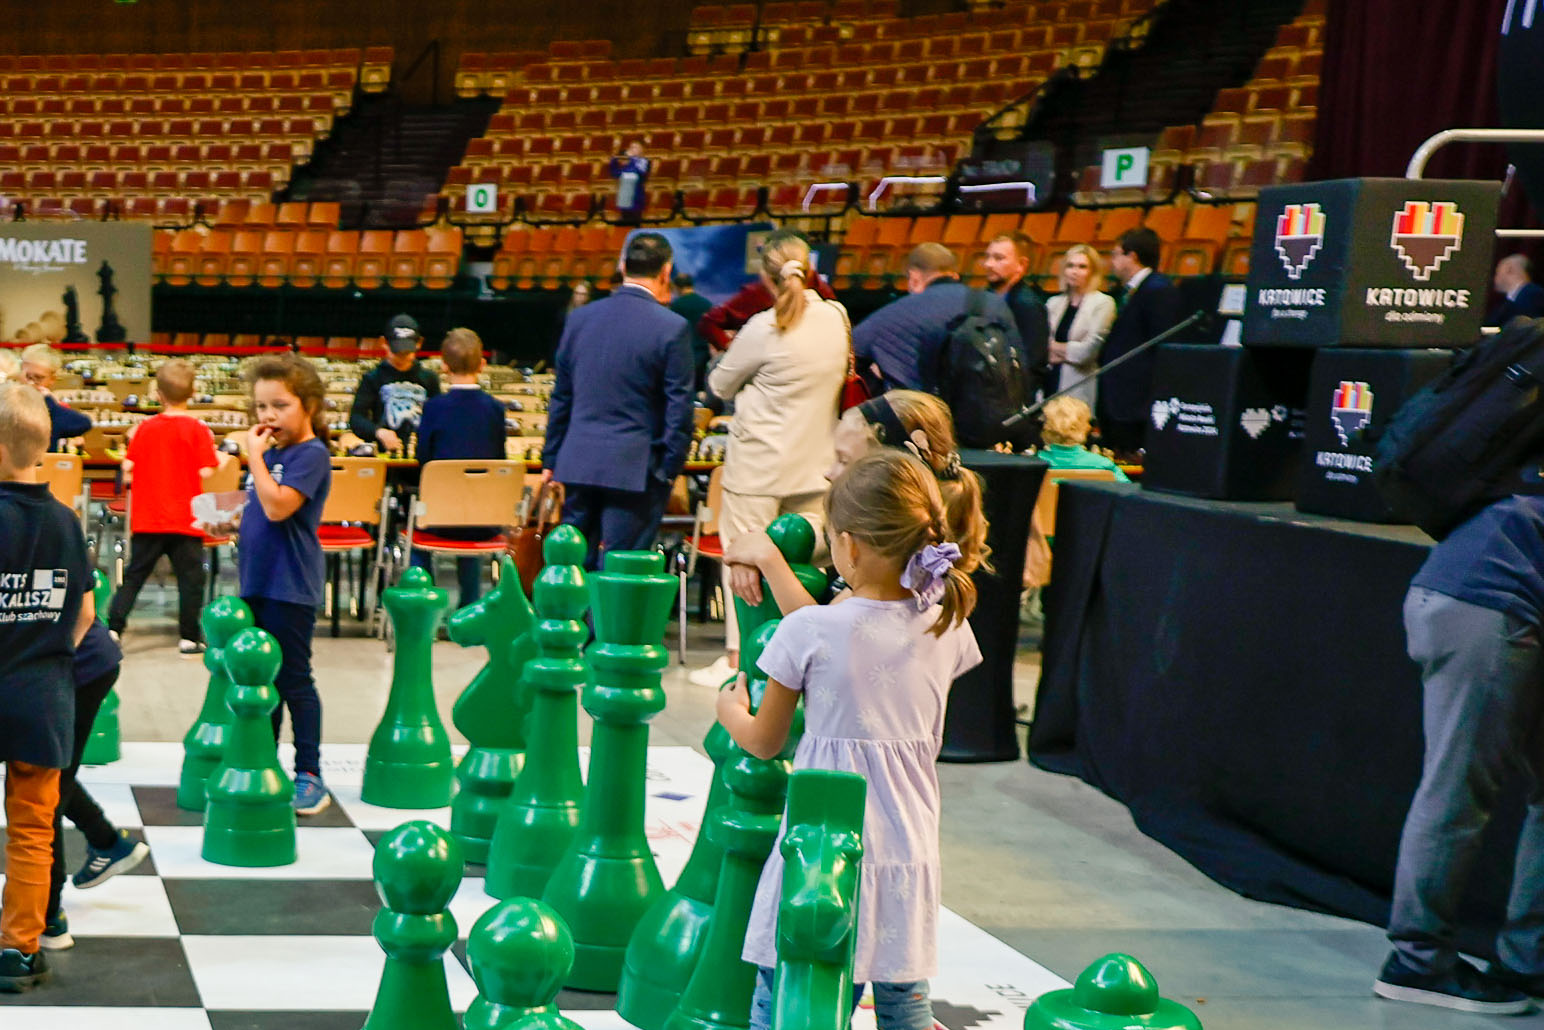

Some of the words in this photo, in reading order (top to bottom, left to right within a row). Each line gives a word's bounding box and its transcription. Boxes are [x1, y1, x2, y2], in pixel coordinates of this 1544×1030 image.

[1116, 154, 1134, 180] P
[1258, 288, 1326, 306] KATOWICE
[1365, 287, 1471, 308] KATOWICE
[0, 573, 27, 588] KTS
